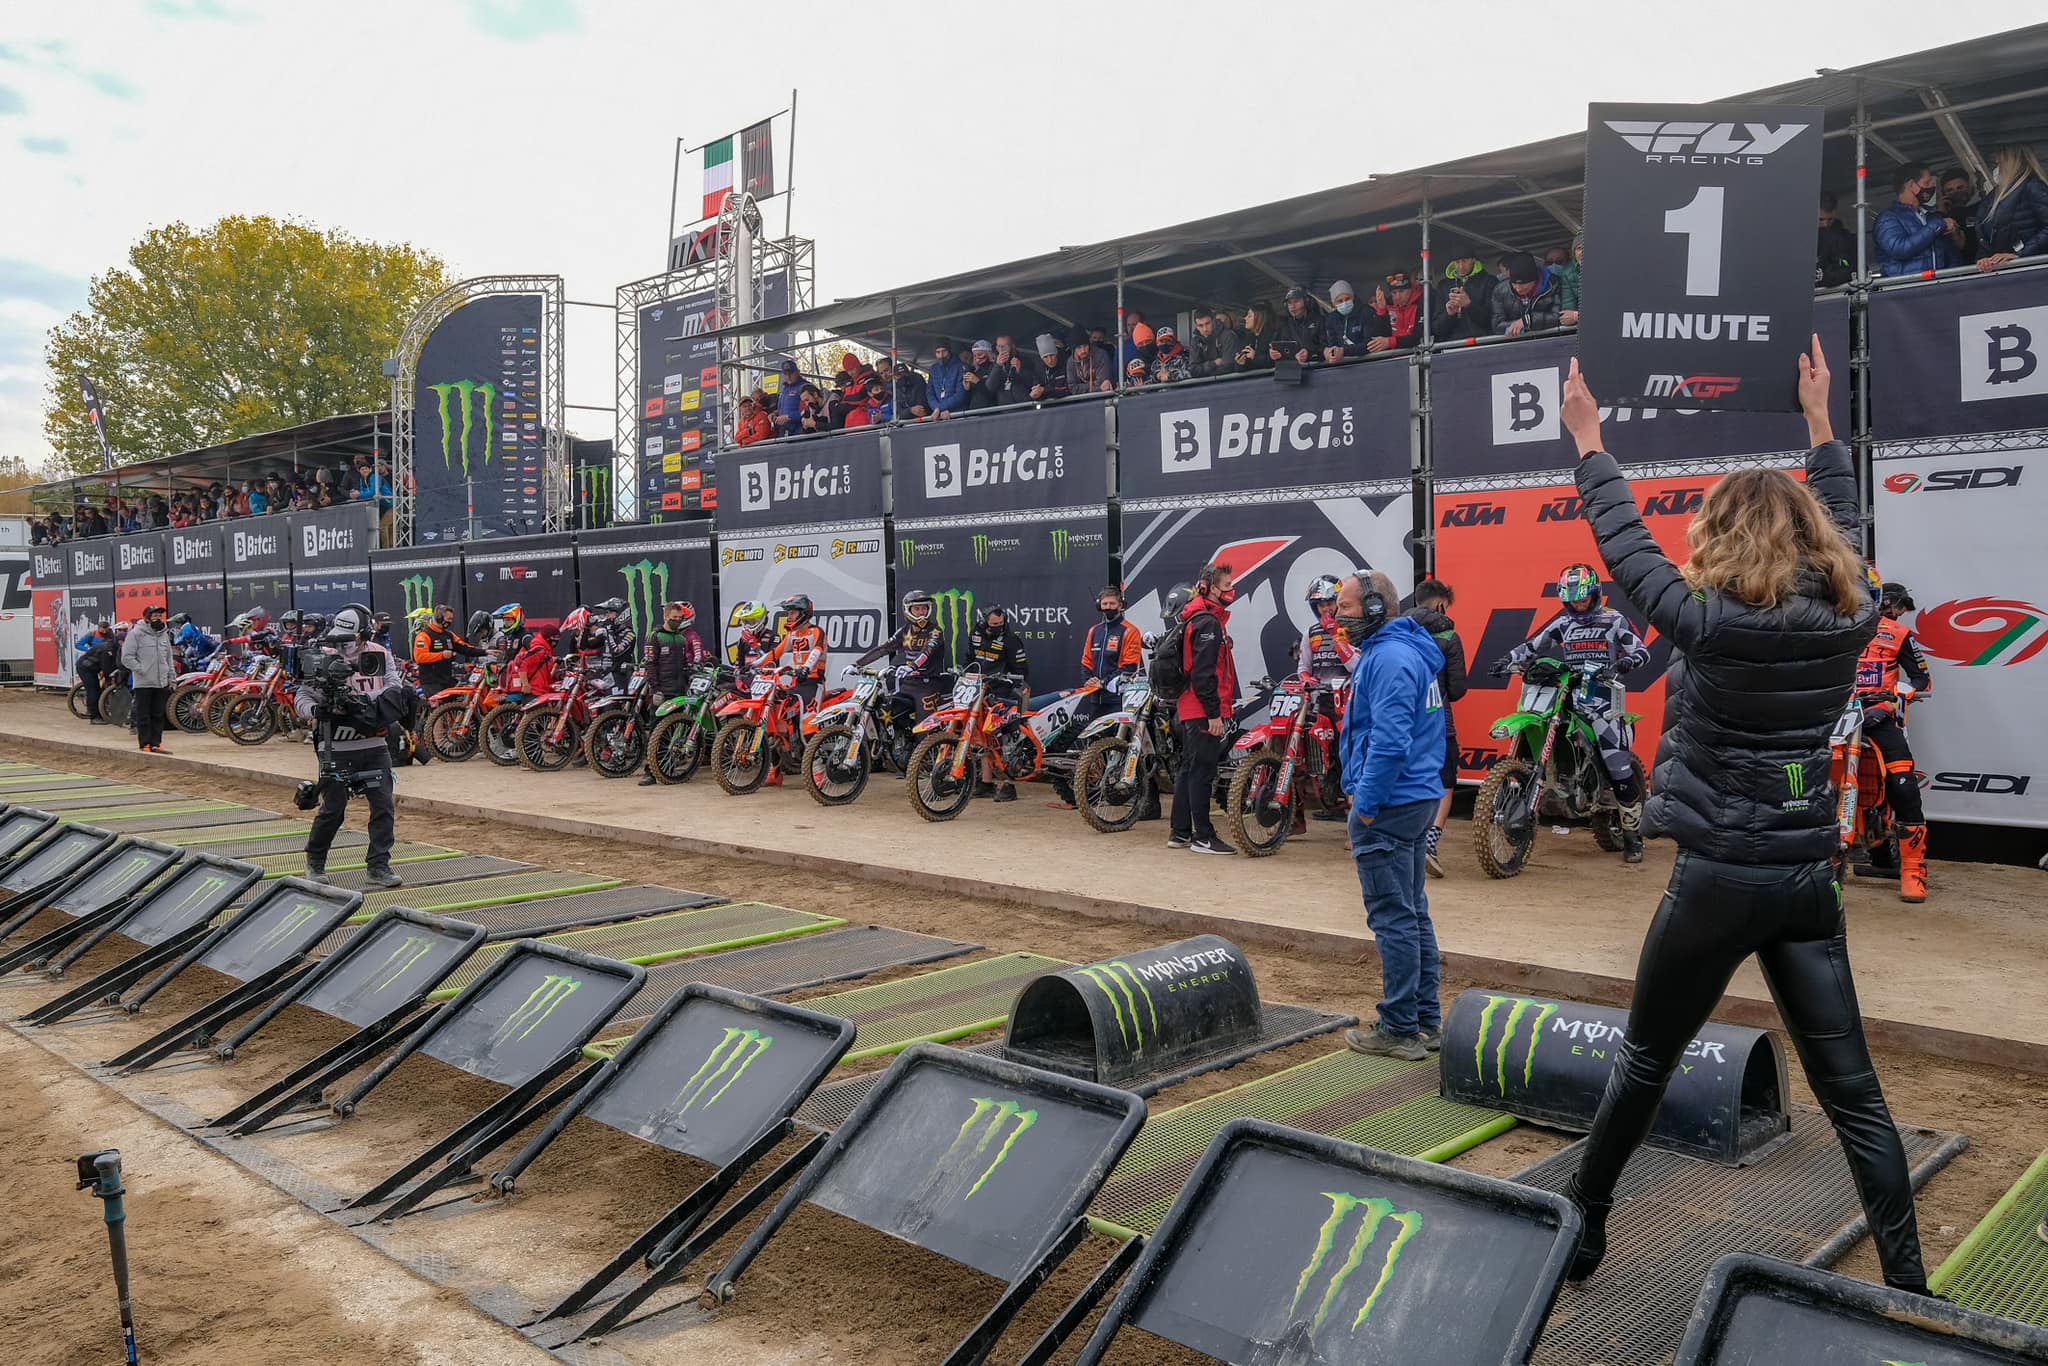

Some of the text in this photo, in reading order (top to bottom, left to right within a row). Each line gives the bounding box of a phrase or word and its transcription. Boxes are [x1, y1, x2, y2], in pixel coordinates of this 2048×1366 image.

[1646, 155, 1763, 165] RACING
[1664, 186, 1724, 296] 1
[1621, 312, 1770, 341] MINUTE
[1643, 374, 1741, 399] MXGP
[1923, 466, 2024, 491] SIDI
[1440, 502, 1506, 528] KTM
[356, 678, 375, 691] TV
[954, 686, 977, 705] 28
[1270, 695, 1301, 717] 516
[1048, 706, 1069, 732] 28
[1930, 772, 2031, 795] SIDI
[1138, 948, 1236, 982] MONSTER
[1167, 969, 1231, 993] ENERGY
